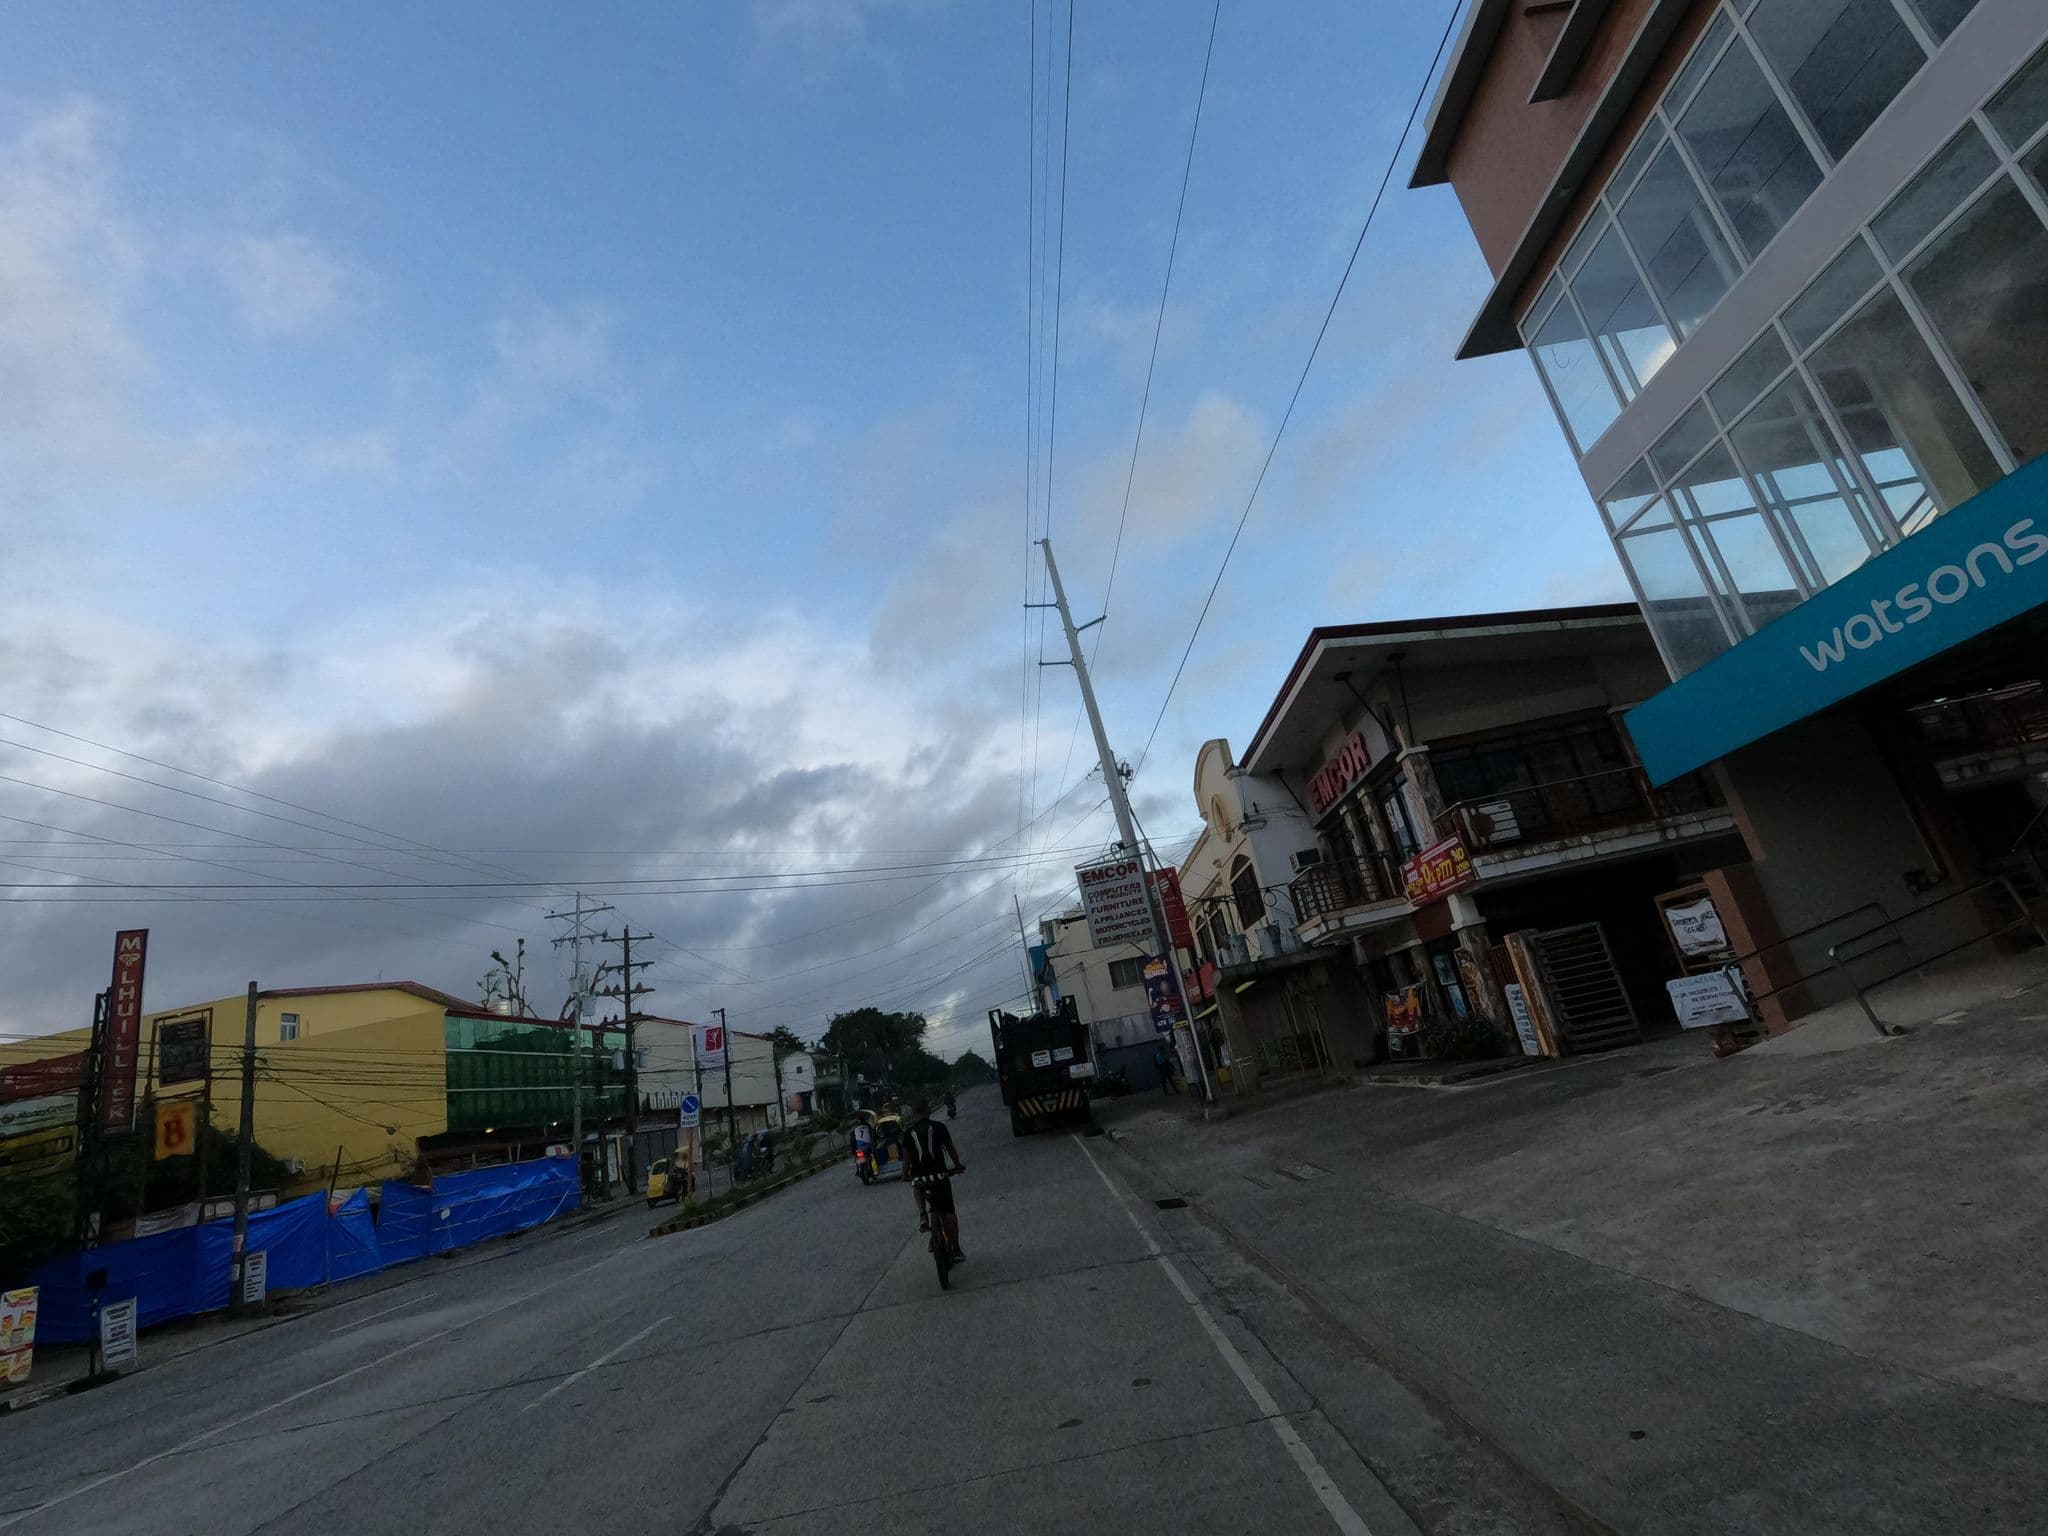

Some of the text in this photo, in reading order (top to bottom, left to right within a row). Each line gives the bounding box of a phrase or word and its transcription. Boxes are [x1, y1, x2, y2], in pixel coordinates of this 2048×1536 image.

[1799, 518, 2048, 671] watsons
[1310, 734, 1370, 811] EMCOR
[1081, 861, 1138, 884] EMCOR
[1088, 882, 1141, 900] COMPUTERS
[1091, 896, 1145, 914] FURNITURE
[1094, 907, 1148, 925] APPLIANCES
[1096, 917, 1151, 934] MOTORCYCLES
[120, 935, 142, 952] M
[1097, 927, 1153, 944] TRI-WHEELER
